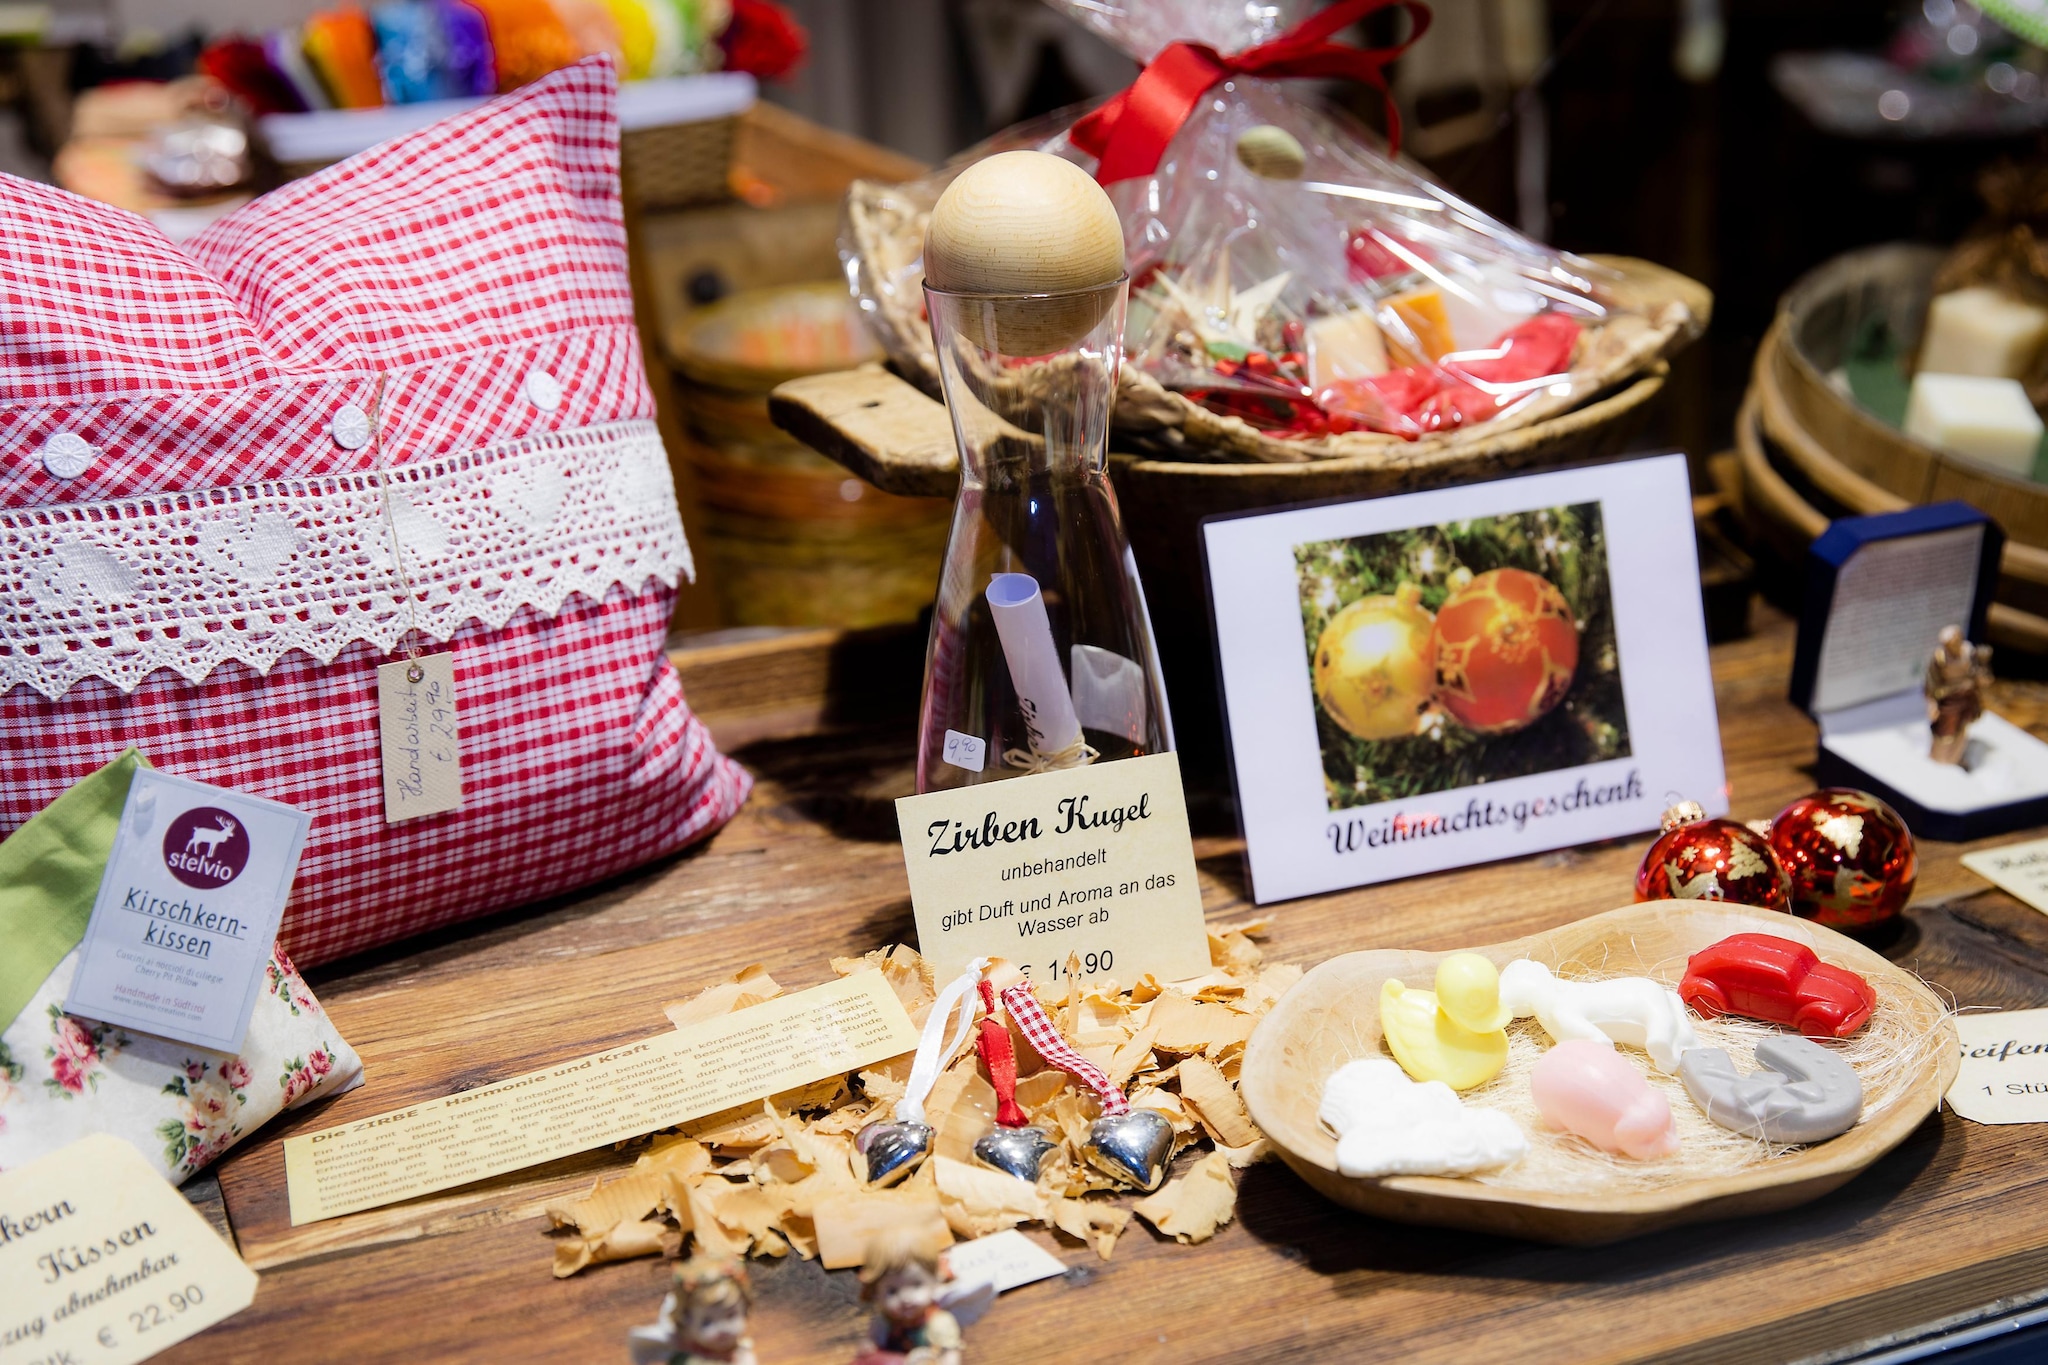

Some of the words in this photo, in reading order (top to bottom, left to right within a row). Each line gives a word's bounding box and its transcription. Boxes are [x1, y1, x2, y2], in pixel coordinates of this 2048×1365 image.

[927, 811, 1043, 857] Zirben
[1054, 793, 1152, 833] Kugel
[1327, 769, 1647, 853] Weihnachtsgeschenk
[168, 850, 233, 881] stelvio
[1001, 849, 1107, 881] unbehandelt
[123, 887, 248, 934] Kirschkern-
[941, 908, 973, 932] gibt
[979, 900, 1014, 921] Duft
[1020, 894, 1051, 914] und
[1057, 885, 1113, 907] Aroma
[1119, 882, 1139, 895] an
[1145, 873, 1176, 891] das
[1018, 914, 1083, 937] Wasser
[1089, 908, 1110, 924] ab
[144, 921, 212, 957] kissen
[114, 984, 160, 1001] Handmade
[162, 995, 171, 1004] in
[135, 965, 161, 979] Cherry
[162, 972, 173, 981] Pit
[175, 975, 198, 988] Pillow
[311, 1128, 345, 1144] Die
[353, 1108, 418, 1133] ZIRBE
[445, 1072, 546, 1108] Harmonie
[553, 1060, 591, 1077] und
[598, 1043, 650, 1064] Kraft
[313, 1147, 332, 1157] Ein
[340, 1137, 368, 1150] Holz
[375, 1131, 396, 1141] mit
[404, 1118, 440, 1133] vielen
[516, 1079, 579, 1103] Entspannt
[585, 1071, 608, 1083] und
[615, 1054, 667, 1075] beruhigt
[674, 1047, 692, 1056] bei
[778, 1011, 807, 1024] oder
[405, 1160, 426, 1171] pro
[592, 1107, 615, 1119] und
[738, 1059, 776, 1075] Macht
[864, 1024, 888, 1036] und
[412, 1121, 460, 1140] Bewirkt
[472, 1111, 498, 1124] eine
[781, 1022, 800, 1032] die
[809, 999, 874, 1024] vegtative
[474, 1122, 492, 1133] die
[700, 1055, 723, 1067] den
[519, 1119, 539, 1130] die
[651, 1077, 685, 1093] Spart
[839, 1016, 883, 1034] Stunde
[1982, 1086, 1992, 1096] 1
[536, 1132, 561, 1145] und
[617, 1110, 640, 1121] das
[554, 1139, 574, 1150] die
[659, 1108, 682, 1120] der
[0, 1200, 76, 1242] kern
[37, 1220, 156, 1284] Kissen
[53, 1253, 180, 1322] abnehmbar
[97, 1326, 119, 1349] €
[129, 1284, 204, 1334] 22,90
